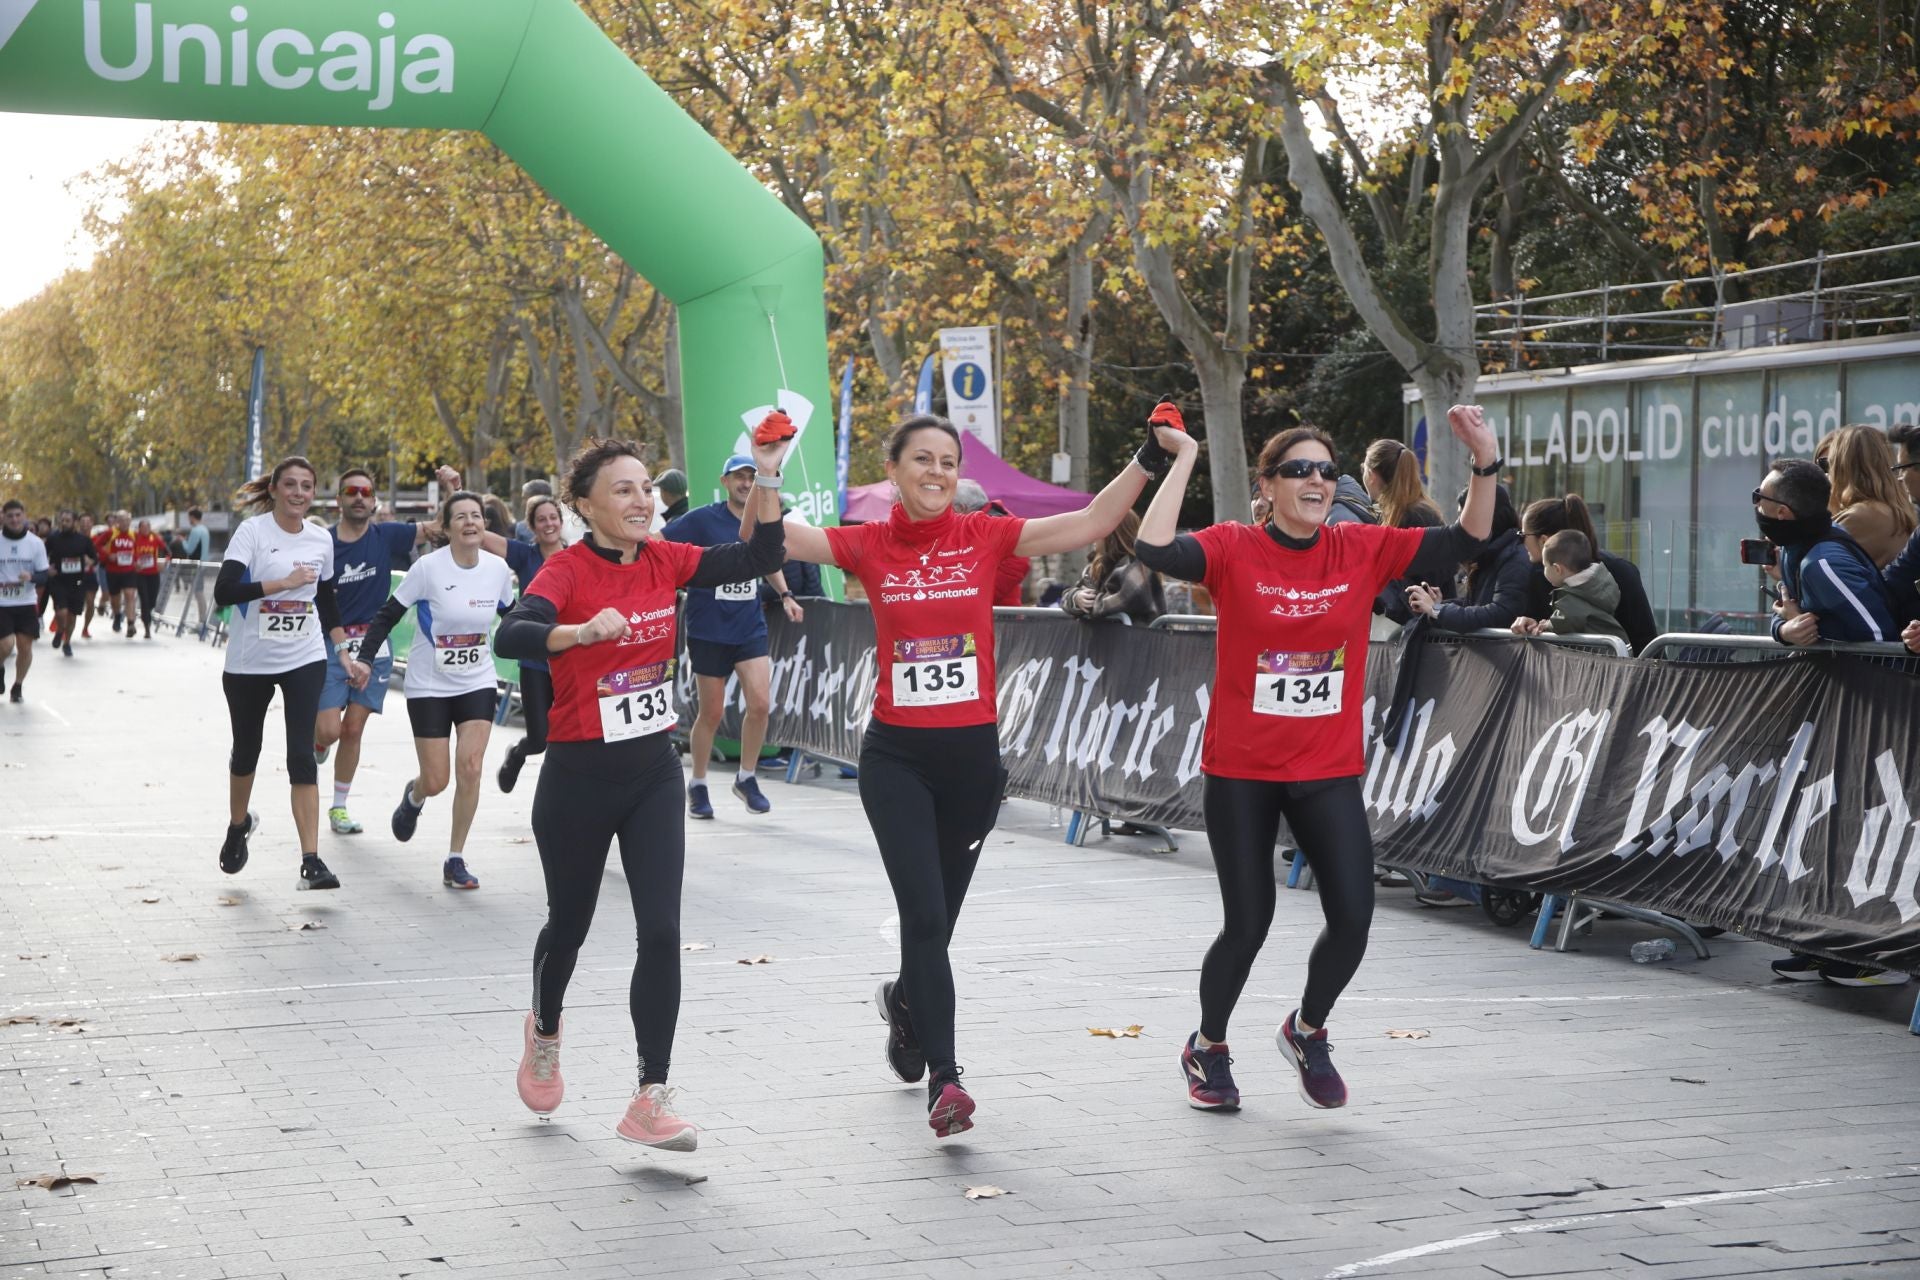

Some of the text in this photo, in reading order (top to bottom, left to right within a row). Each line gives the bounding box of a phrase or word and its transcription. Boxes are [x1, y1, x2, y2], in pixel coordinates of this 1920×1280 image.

[83, 0, 455, 111] Unicaja
[1702, 391, 1842, 458] ciudad
[722, 581, 752, 594] 655
[881, 587, 979, 605] Sports Santander
[1256, 582, 1287, 597] Sports
[267, 615, 307, 632] 257
[915, 639, 940, 647] CARRERA
[916, 645, 949, 654] EMPRESAS
[443, 648, 479, 665] 256
[1289, 660, 1320, 668] EMPRESAS
[629, 672, 657, 684] EMPRESAS
[903, 662, 965, 693] 135
[1270, 676, 1330, 704] 134
[615, 688, 667, 725] 133
[1044, 654, 1175, 782] Norte
[1612, 714, 1837, 884] Norte
